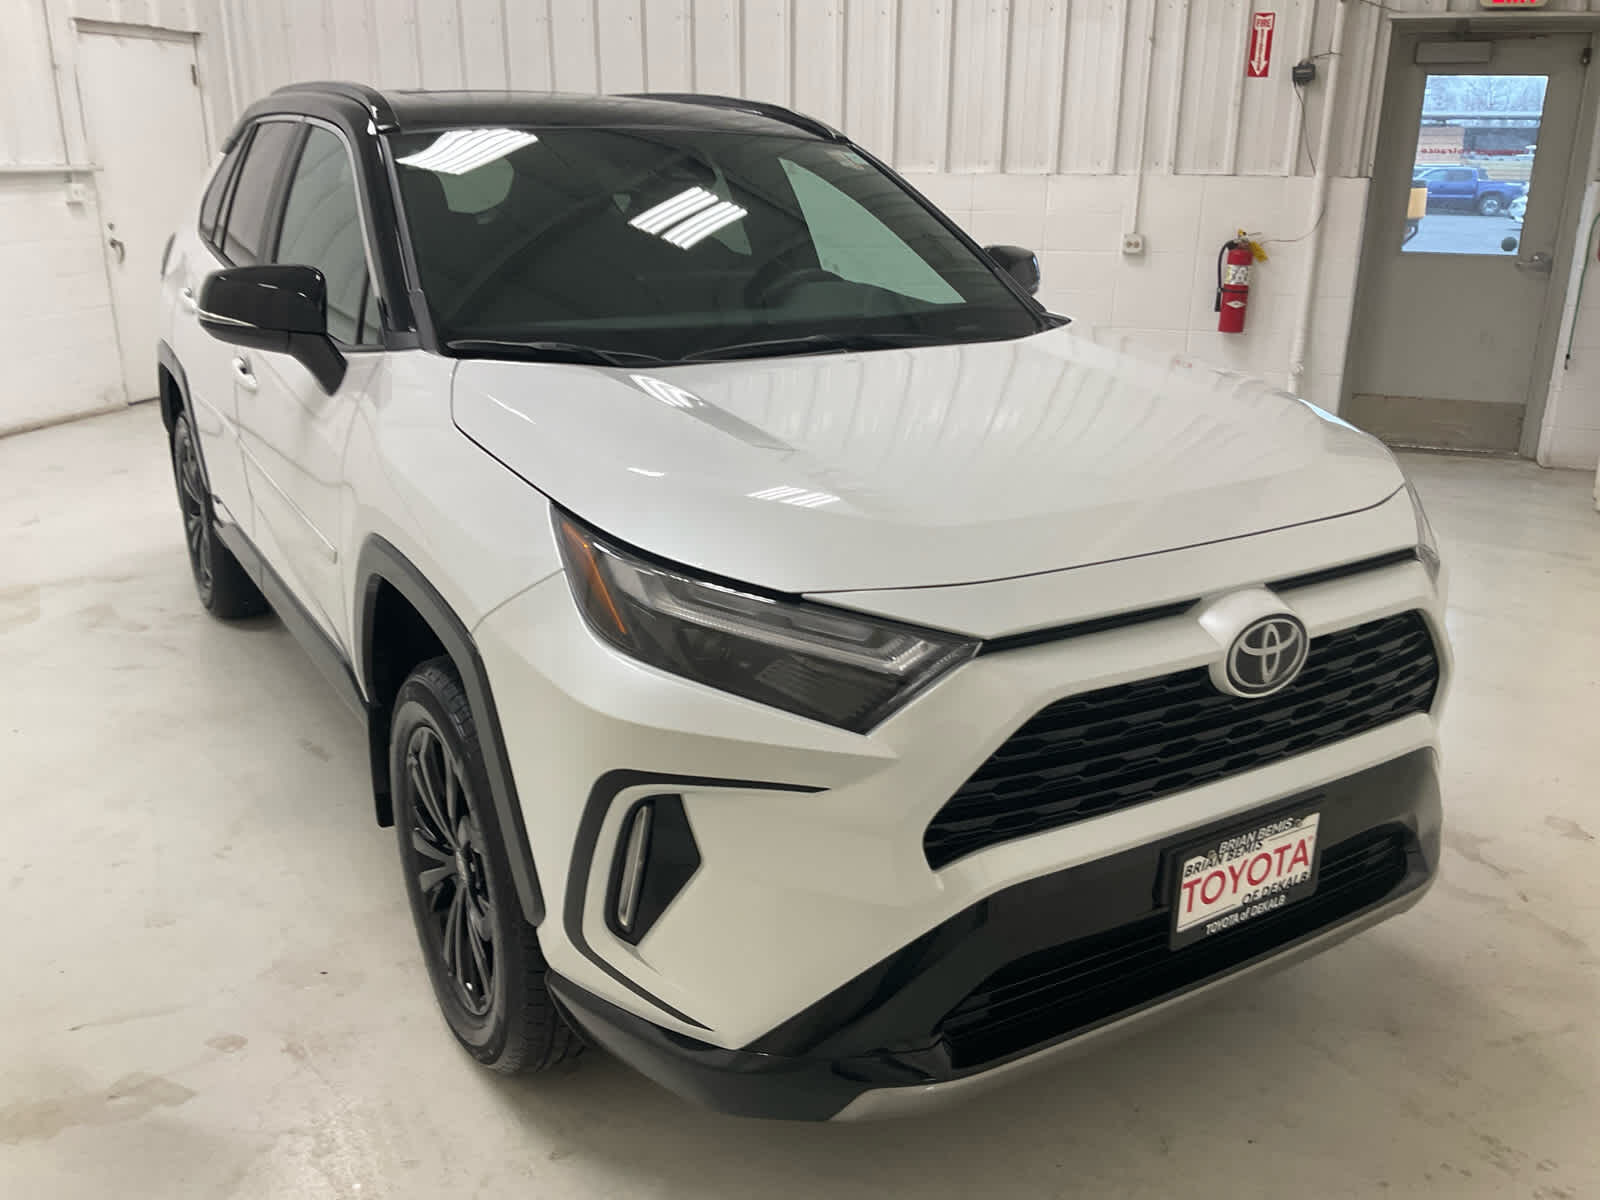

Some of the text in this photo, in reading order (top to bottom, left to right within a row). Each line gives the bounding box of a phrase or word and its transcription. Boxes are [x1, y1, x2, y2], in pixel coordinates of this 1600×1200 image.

[1256, 18, 1272, 28] FIRE
[1219, 817, 1294, 854] BRIAN BEMIS
[1182, 838, 1310, 913] TOYOTA
[1184, 840, 1263, 877] BRIAN BEMIS
[1205, 912, 1240, 935] TOYOTA
[1250, 894, 1287, 917] DEKALB
[1242, 888, 1260, 904] OF
